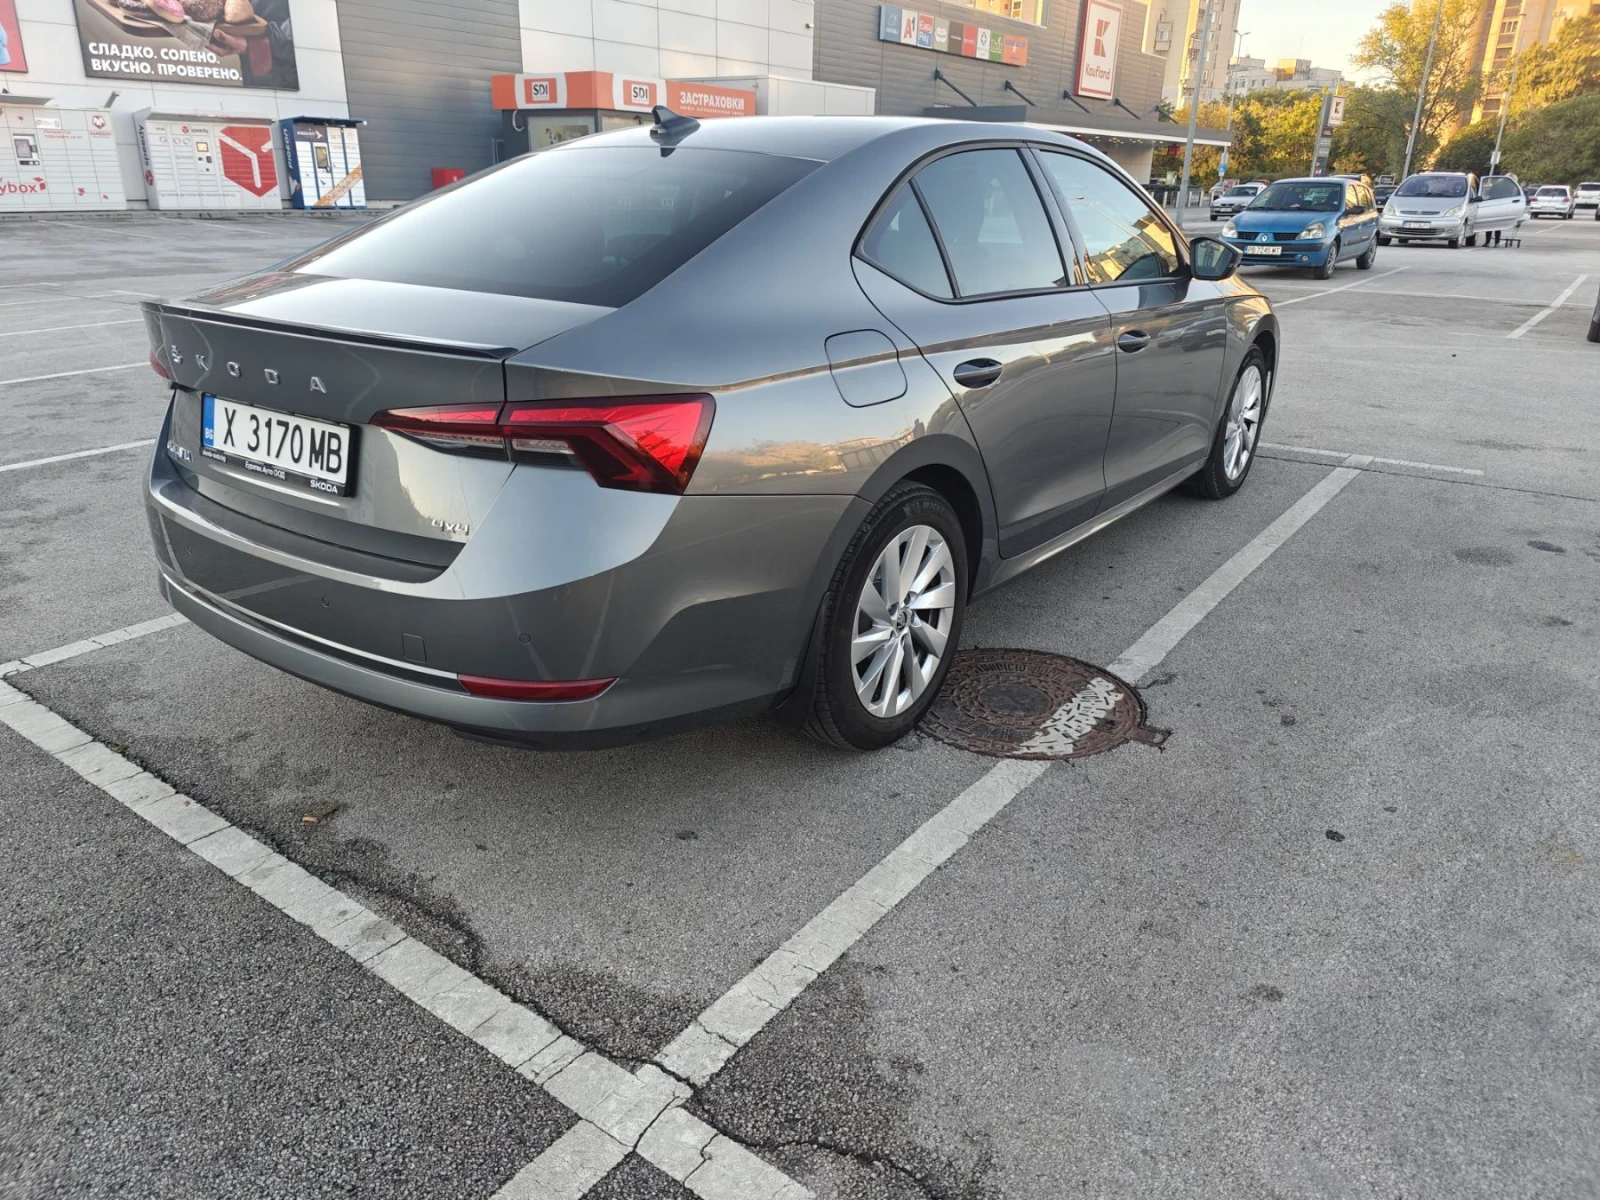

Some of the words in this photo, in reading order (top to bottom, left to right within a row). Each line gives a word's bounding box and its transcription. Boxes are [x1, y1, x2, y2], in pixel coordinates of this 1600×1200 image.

[903, 16, 916, 39] A1
[919, 31, 930, 45] Pay
[88, 42, 157, 60] СЛАДКО.
[160, 48, 221, 65] СОЛЕНО.
[91, 58, 155, 75] ВКУСНО.
[157, 63, 243, 81] ПРОВЕРЕНО.
[1086, 63, 1111, 80] Kaufland
[533, 83, 549, 96] SDI
[632, 86, 648, 99] SDI
[680, 91, 745, 110] ЗАСТРАХОВКИ
[138, 124, 150, 167] speedy
[205, 427, 214, 439] BG
[223, 406, 237, 448] X
[247, 413, 304, 464] 3170
[308, 427, 342, 474] MB
